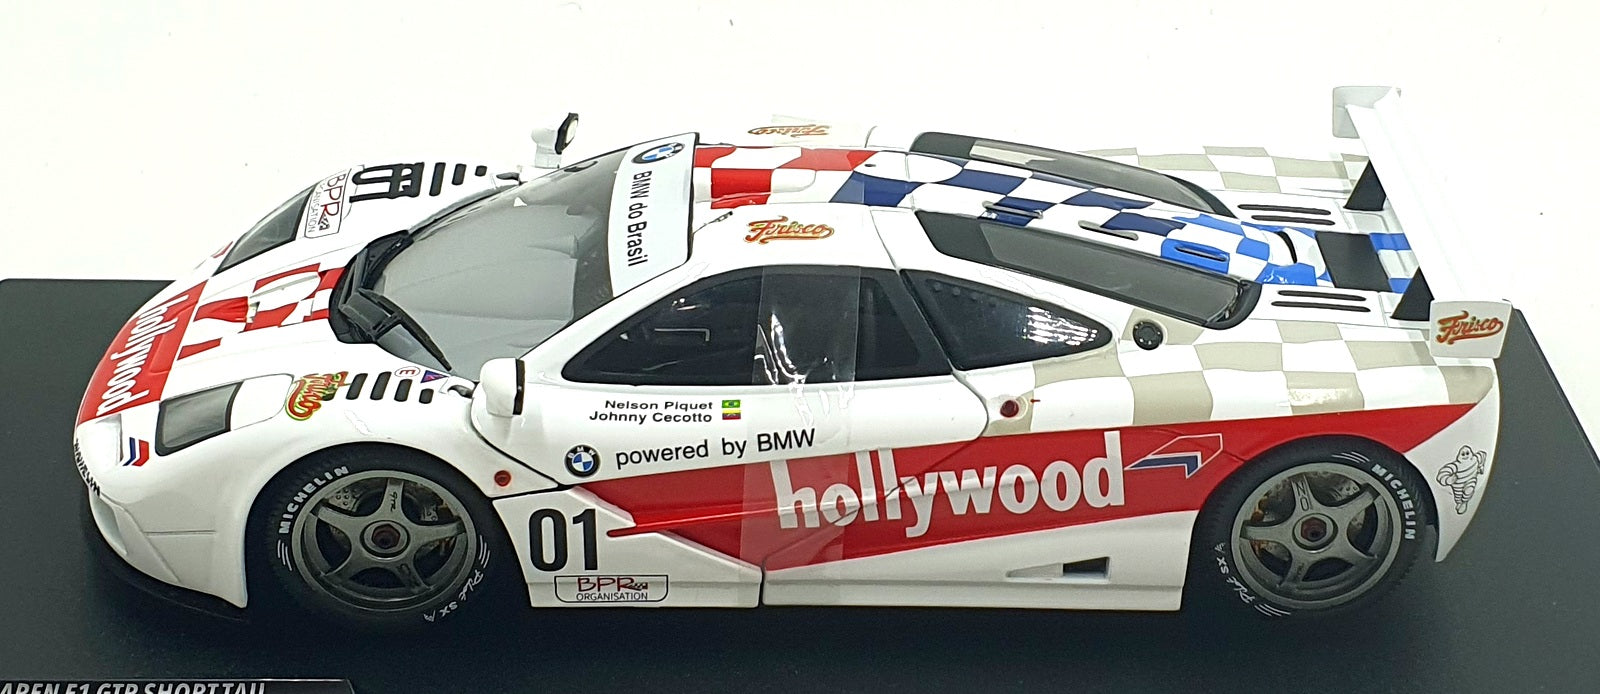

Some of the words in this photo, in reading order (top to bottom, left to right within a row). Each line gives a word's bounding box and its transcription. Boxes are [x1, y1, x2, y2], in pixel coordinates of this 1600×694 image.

[318, 174, 346, 225] BPR
[630, 171, 652, 199] BMW
[628, 203, 648, 219] do
[627, 221, 648, 267] Brasil
[743, 215, 835, 244] Frisco
[1436, 310, 1504, 345] Frisco
[96, 294, 189, 417] hollywood
[589, 411, 647, 425] Johnny
[652, 412, 712, 423] Cecotto
[605, 400, 659, 410] Nelson
[664, 400, 713, 412] Piquet
[615, 439, 709, 470] powered
[721, 437, 747, 459] by
[757, 428, 816, 452] BMW
[279, 466, 349, 534] MICHELIN
[769, 430, 1125, 538] hollywood
[1372, 463, 1416, 540] MICHELIN
[528, 508, 598, 572] 01
[1216, 556, 1229, 574] SX
[576, 592, 648, 601] ORGANISATION
[577, 577, 640, 592] BPR
